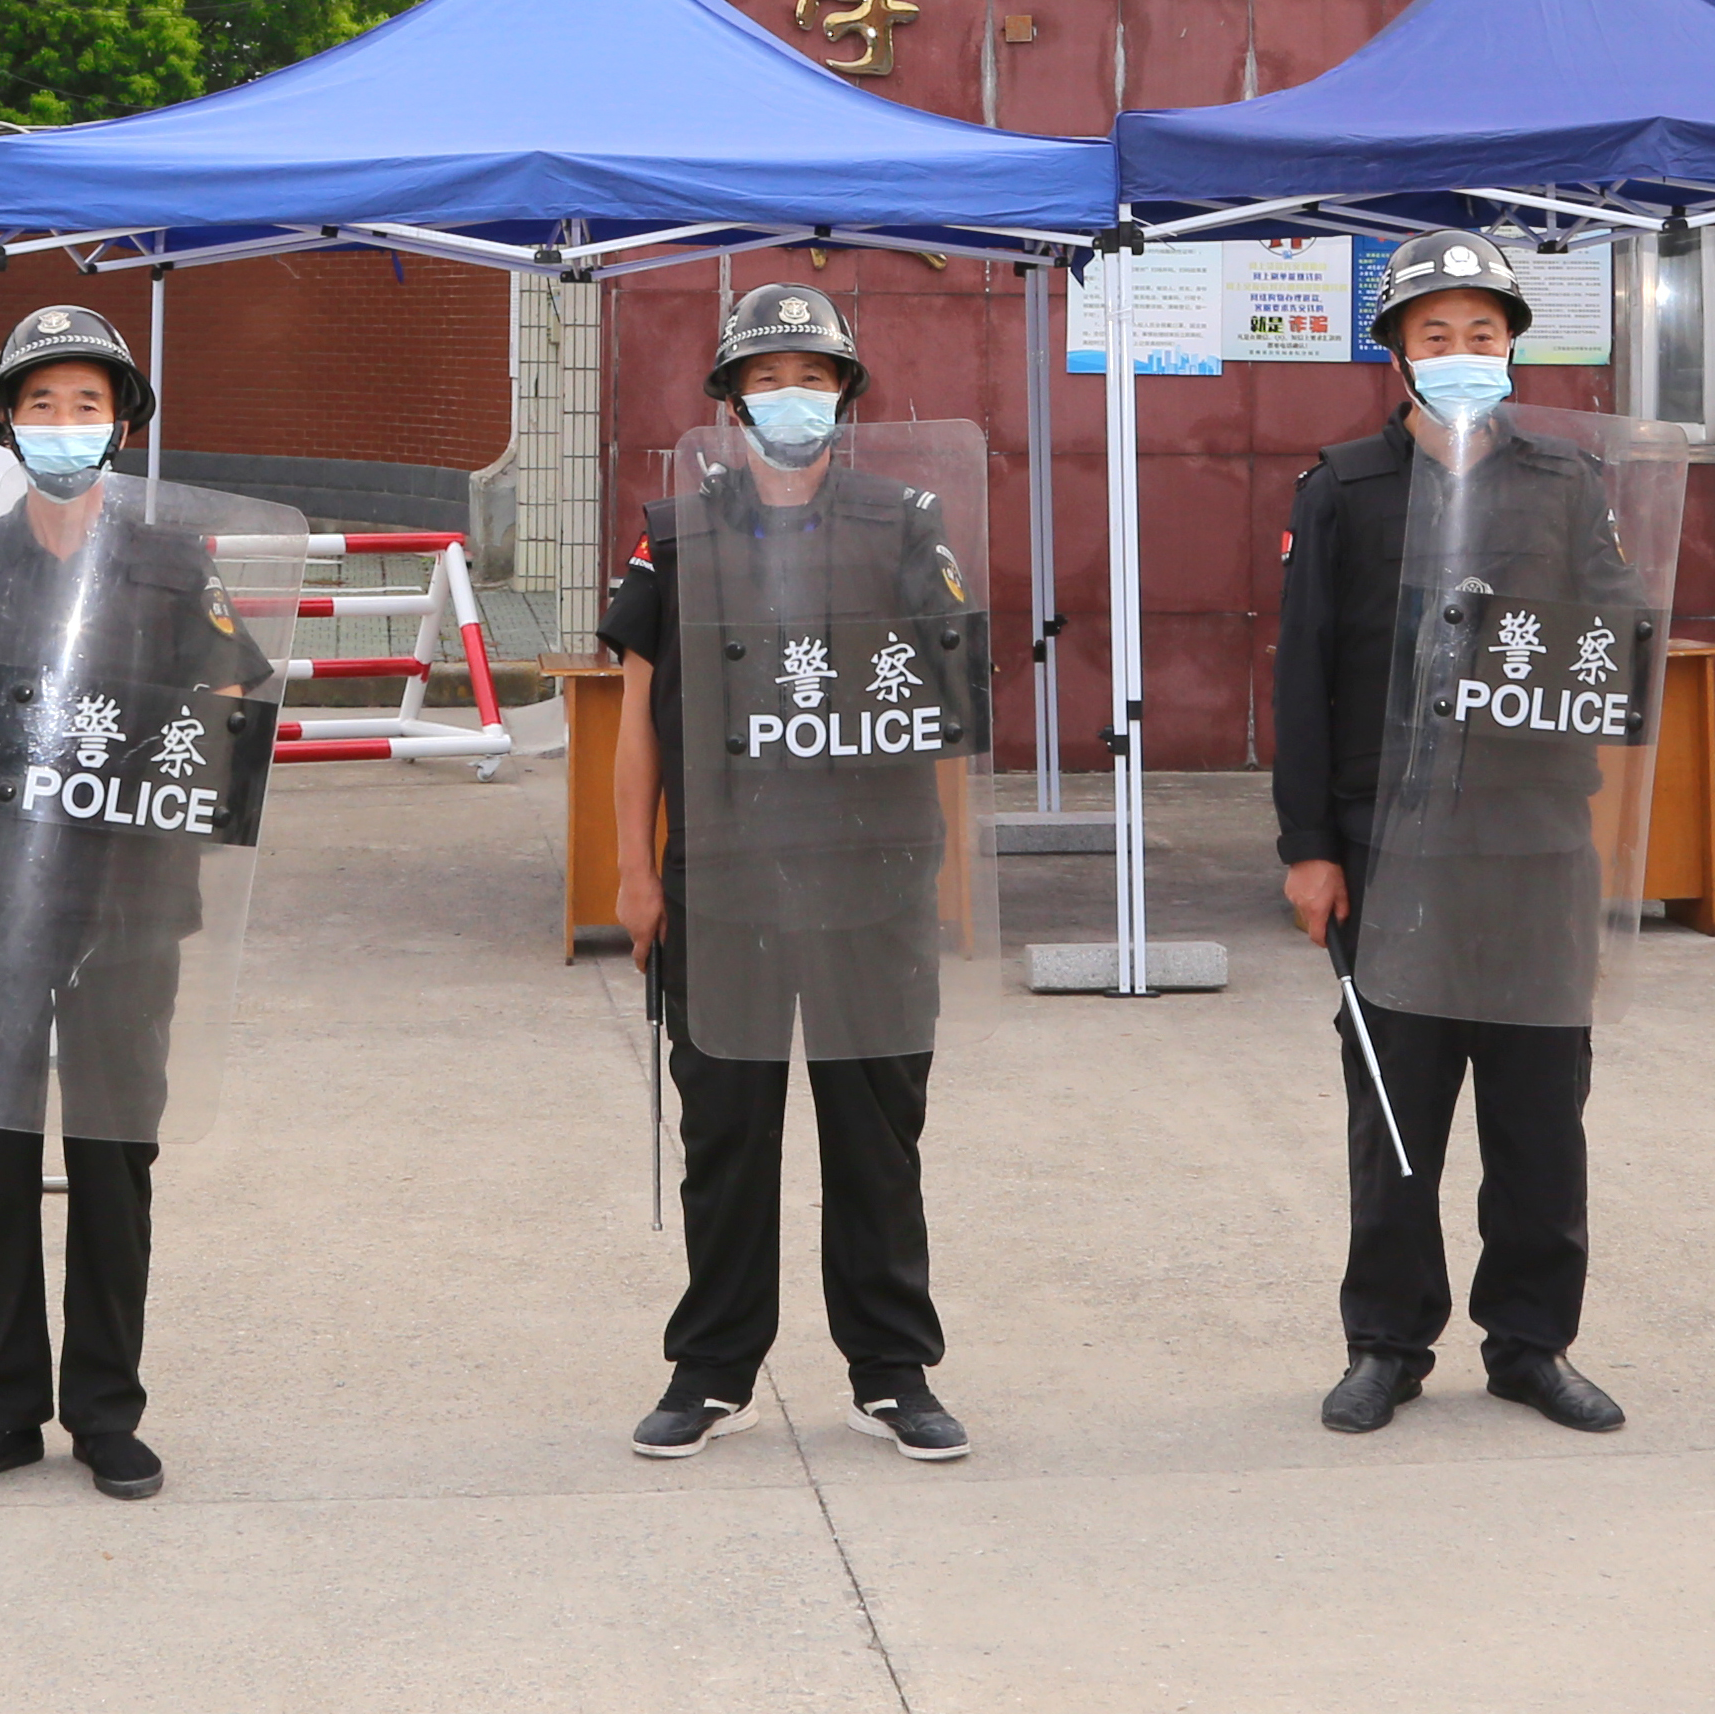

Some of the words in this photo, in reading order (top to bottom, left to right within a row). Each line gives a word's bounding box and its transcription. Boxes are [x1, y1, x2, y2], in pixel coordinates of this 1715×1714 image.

[1250, 315, 1284, 333] 就是
[1289, 315, 1328, 333] 诈骗
[775, 632, 923, 709] 警察
[1488, 610, 1618, 686] 警察
[62, 694, 207, 778] 警察
[749, 706, 943, 759] POLICE
[1455, 679, 1629, 736] POLICE
[22, 765, 218, 835] POLICE
